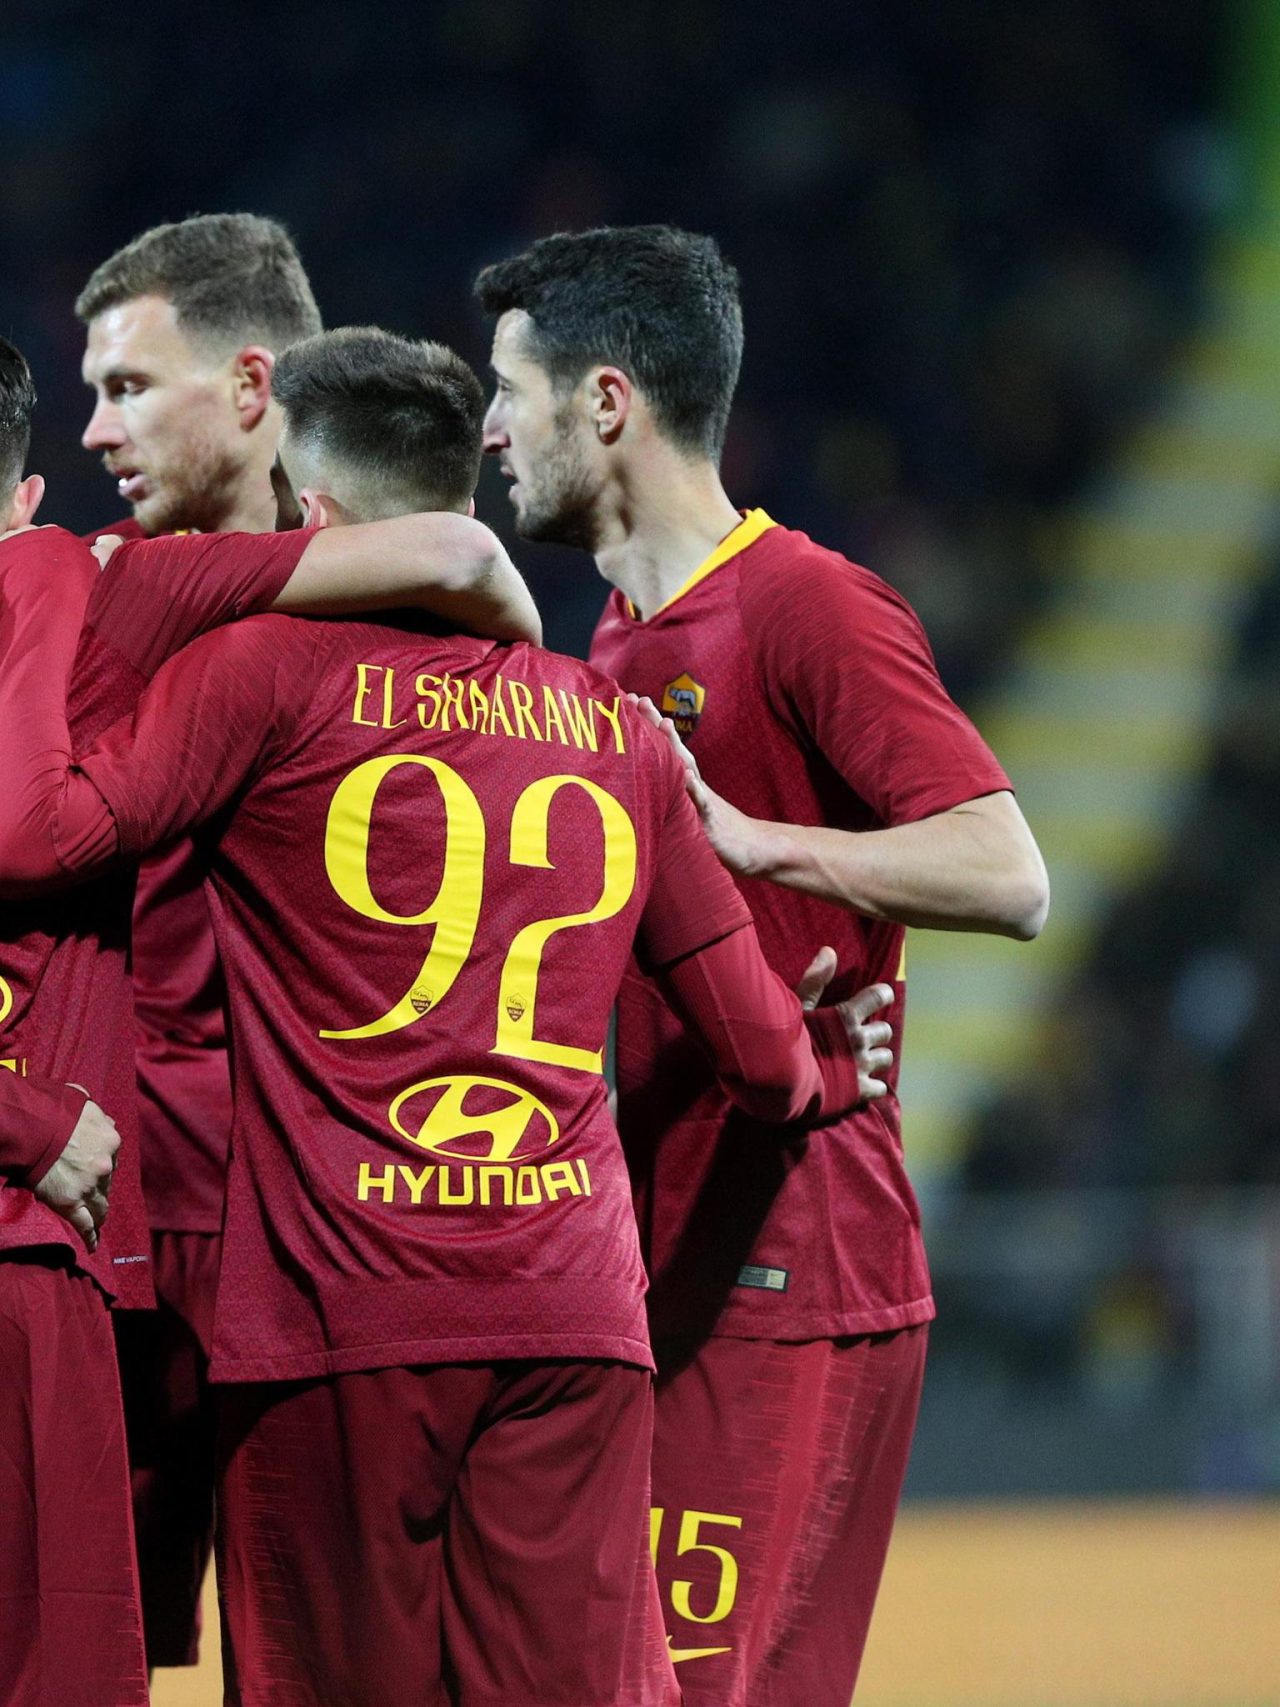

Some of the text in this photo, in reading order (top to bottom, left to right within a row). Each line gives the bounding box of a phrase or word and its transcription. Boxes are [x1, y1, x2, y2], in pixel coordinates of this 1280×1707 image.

[351, 663, 626, 754] EL SHAARAWY
[318, 753, 638, 1075] 92
[356, 1158, 592, 1206] HYUNDAI
